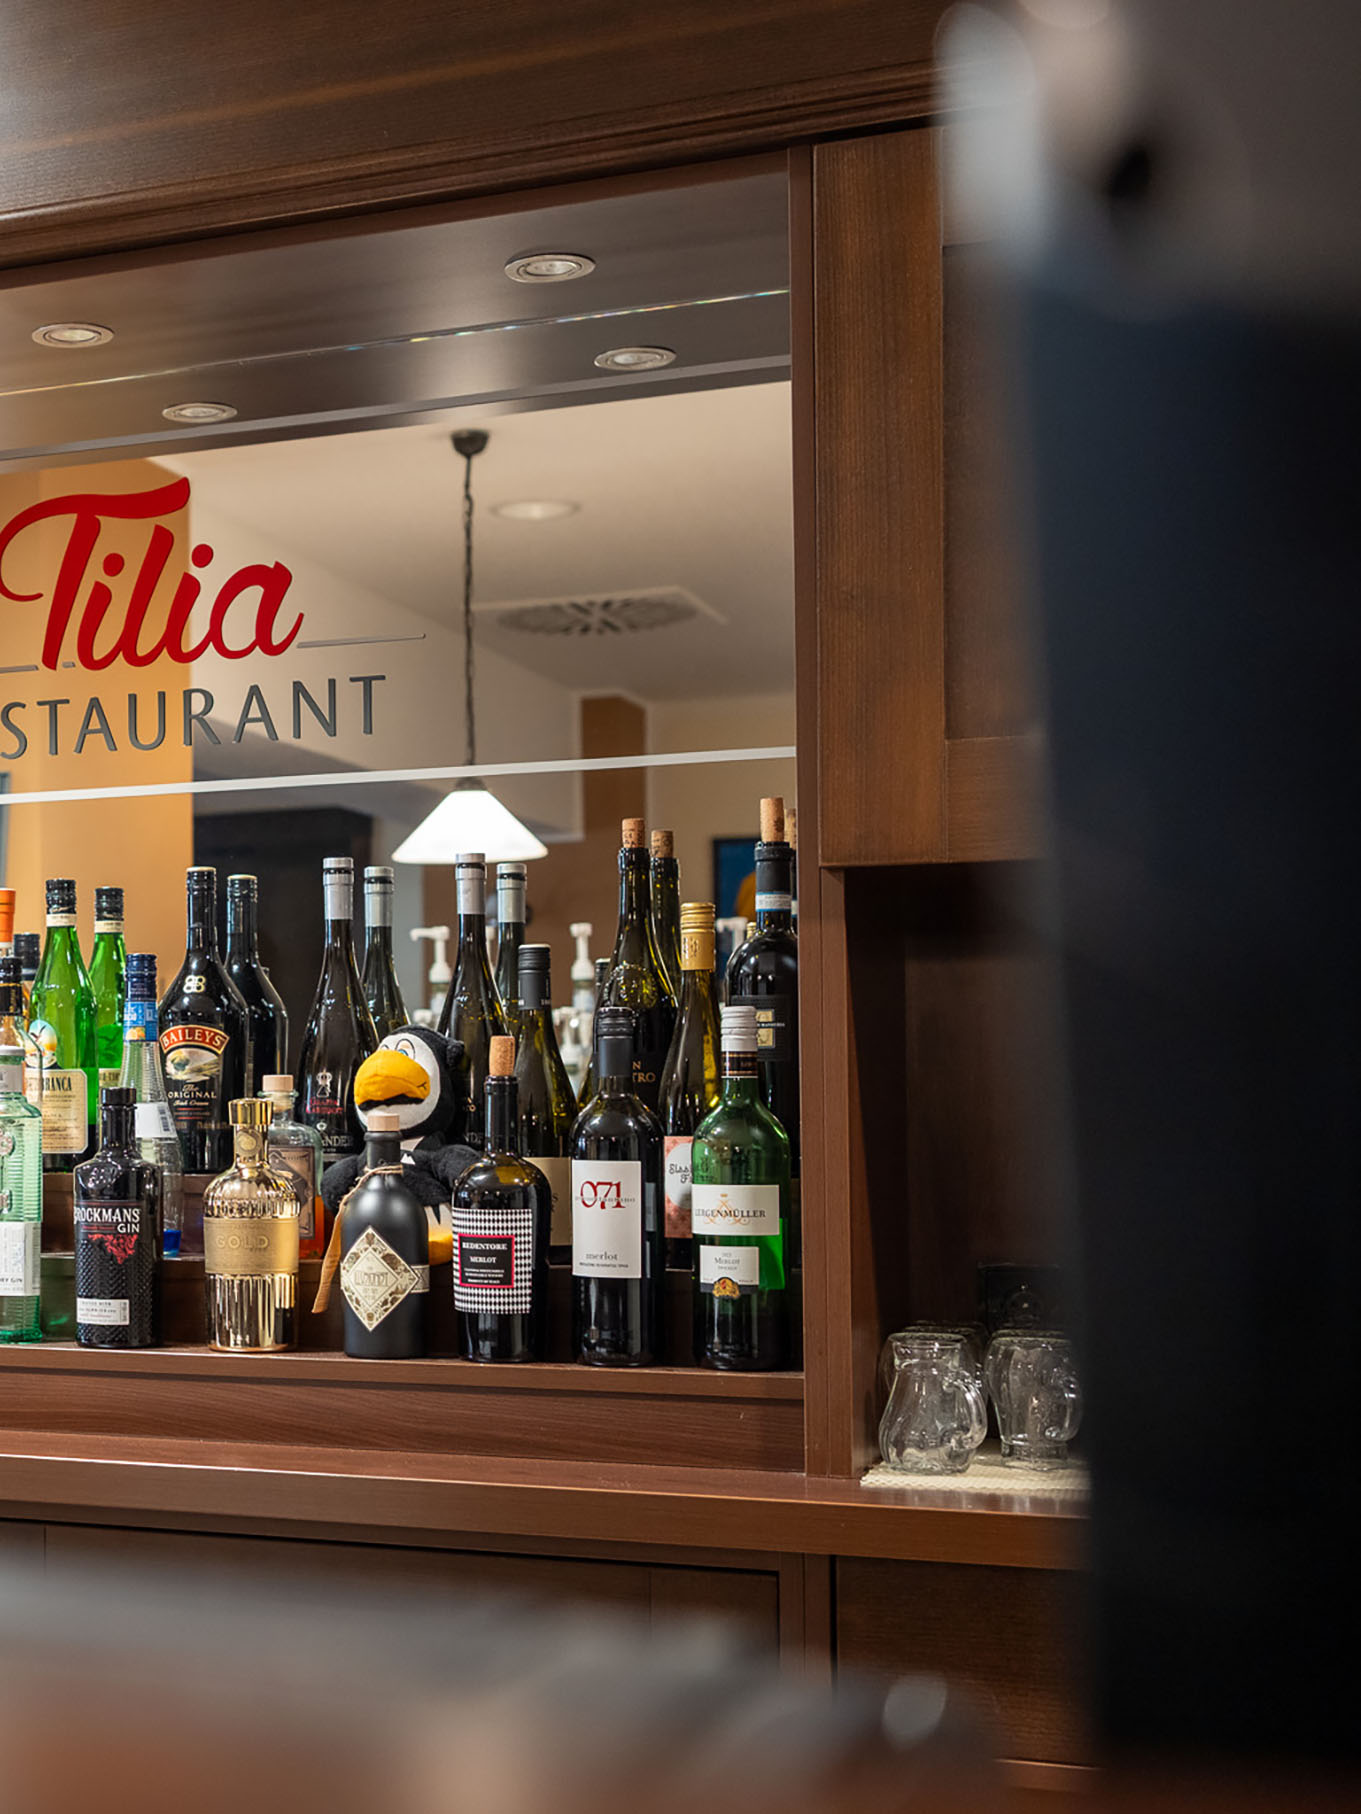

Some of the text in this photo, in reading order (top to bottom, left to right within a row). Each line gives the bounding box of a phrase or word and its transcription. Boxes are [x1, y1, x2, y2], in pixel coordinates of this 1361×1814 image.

[162, 1029, 222, 1048] BAILEYS
[168, 1091, 216, 1099] ORIGINAL
[580, 1181, 627, 1210] 071
[116, 1223, 141, 1233] GIN
[215, 1234, 270, 1250] GOLD
[462, 1242, 508, 1250] REDENTORE
